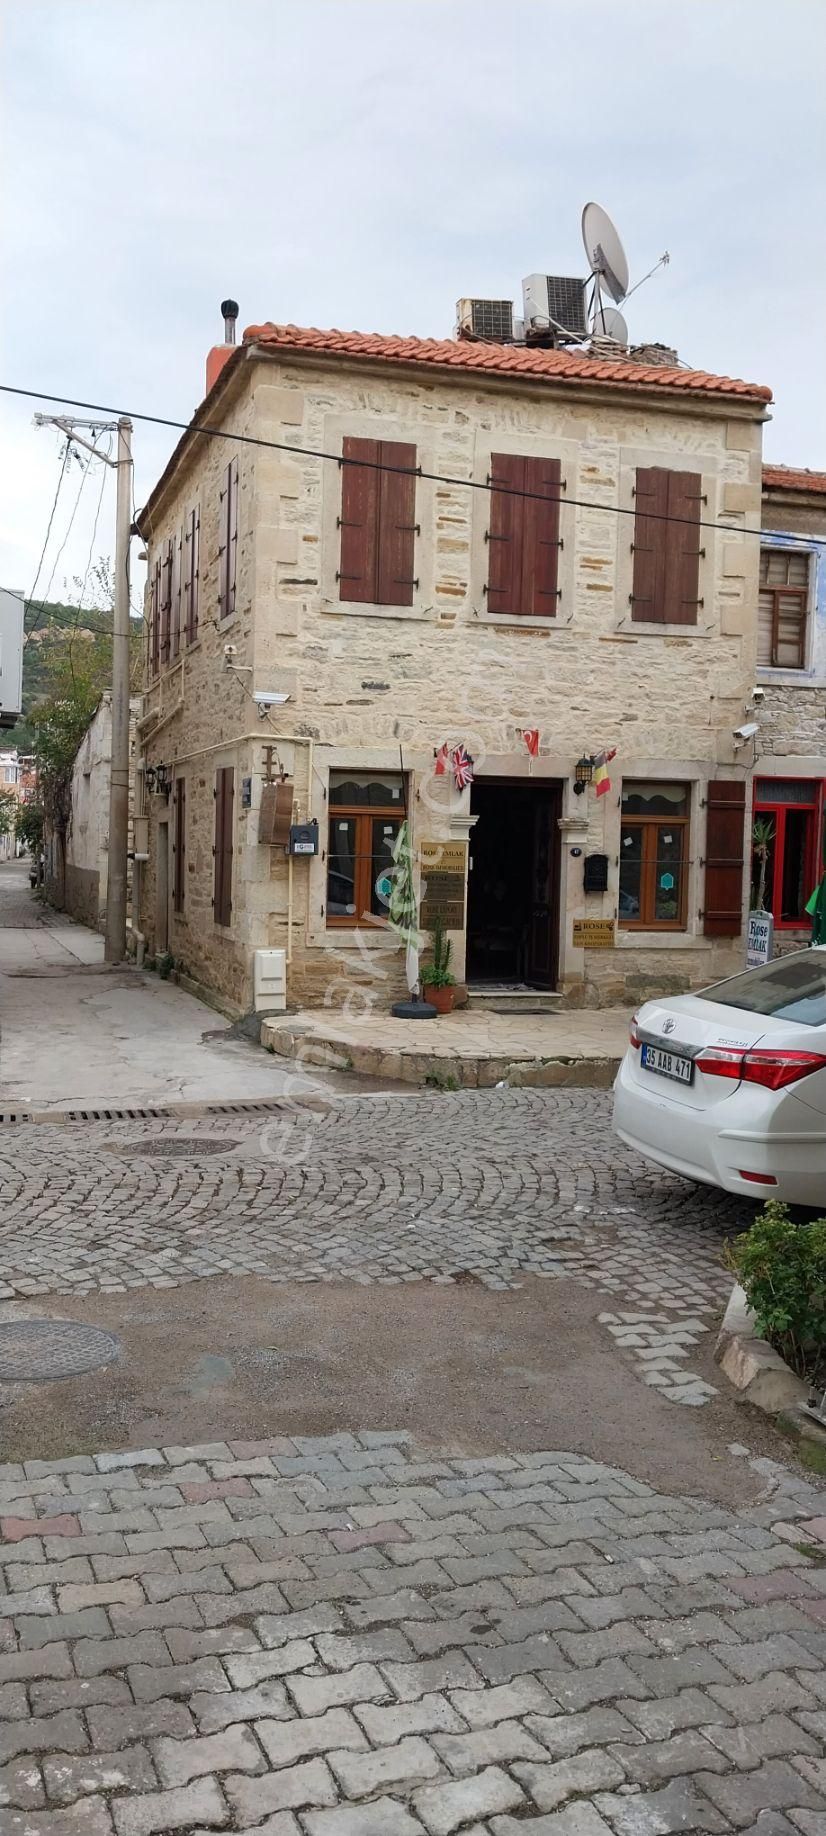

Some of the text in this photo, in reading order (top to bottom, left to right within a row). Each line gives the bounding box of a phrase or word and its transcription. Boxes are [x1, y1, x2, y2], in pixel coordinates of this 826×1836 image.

[583, 922, 606, 930] ROSE
[750, 920, 768, 938] Rose
[647, 1048, 691, 1079] 35 AAB 471
